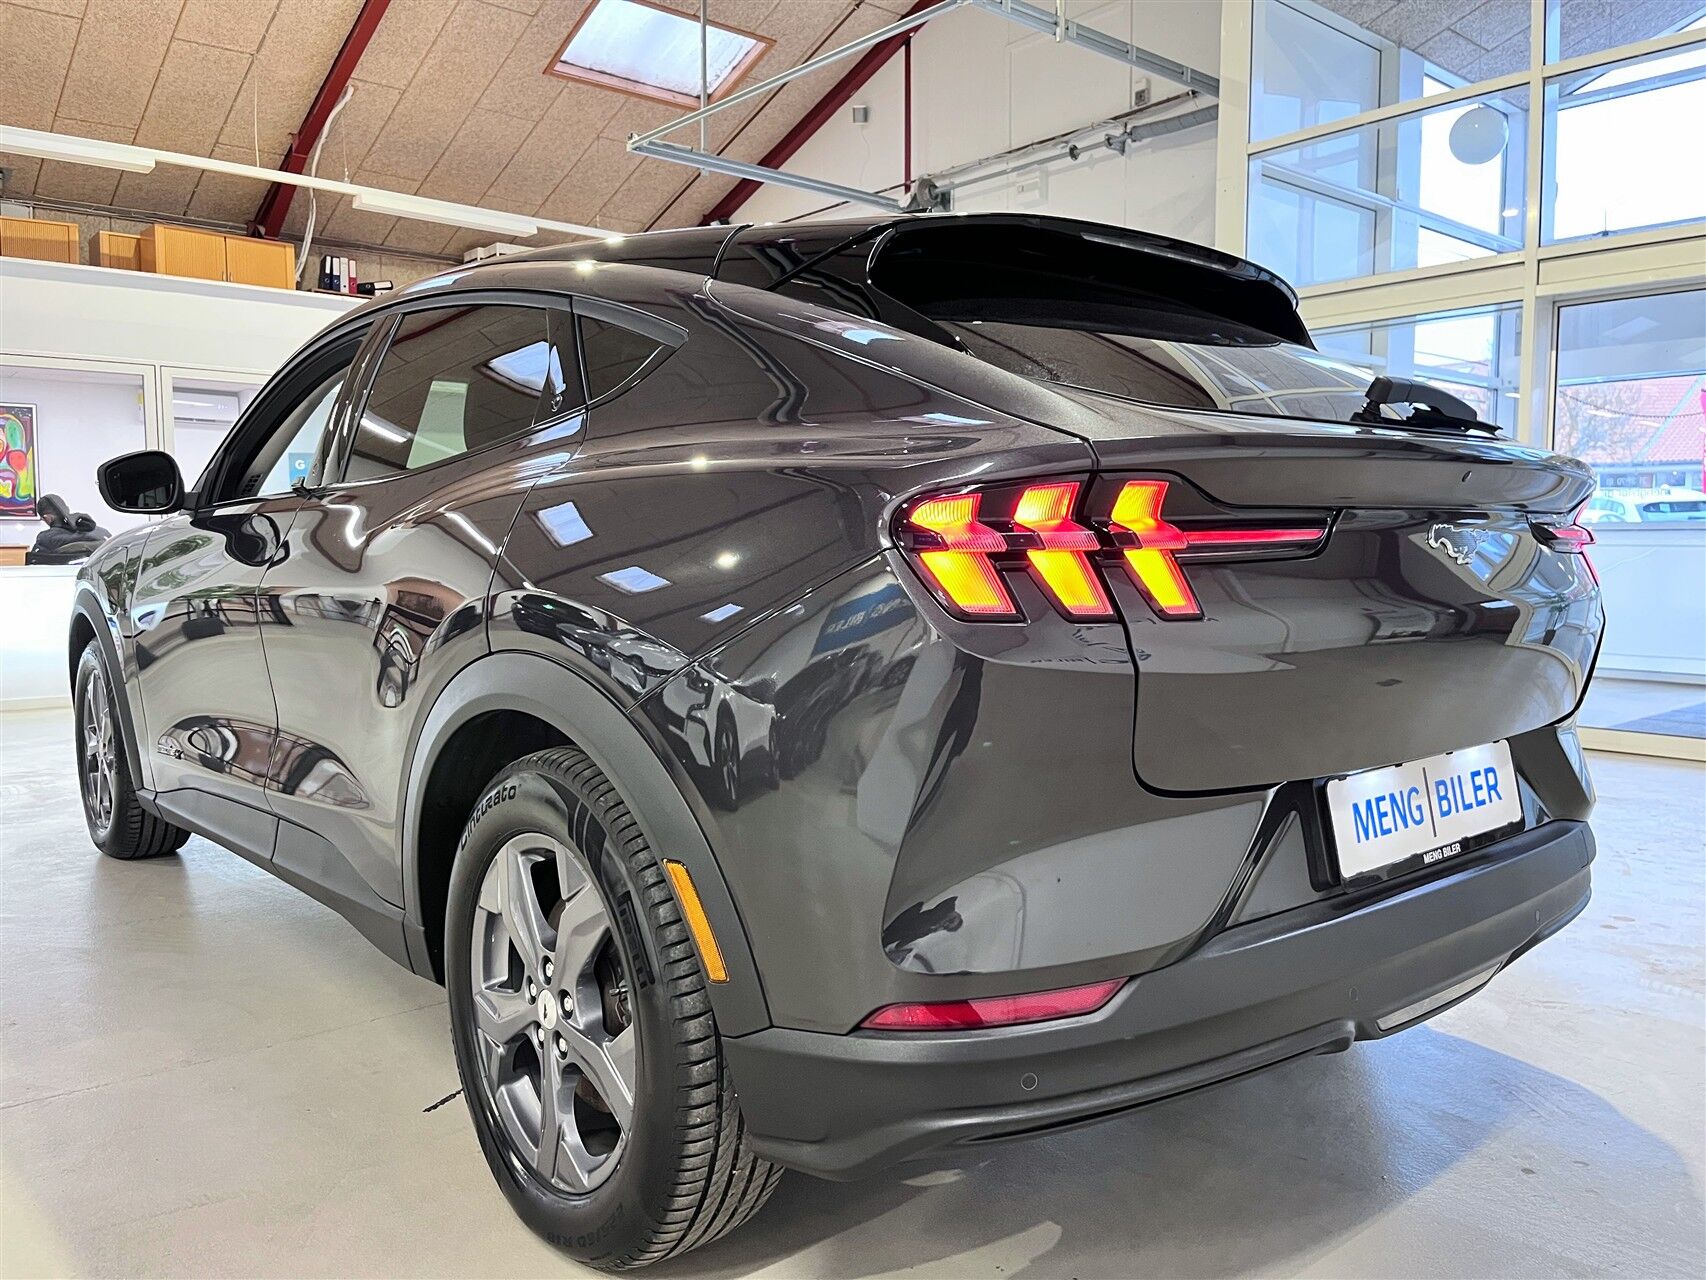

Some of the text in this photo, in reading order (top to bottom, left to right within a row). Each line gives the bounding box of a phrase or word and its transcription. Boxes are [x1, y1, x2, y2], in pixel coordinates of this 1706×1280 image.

[1352, 766, 1503, 844] MENG BILER
[1422, 843, 1462, 864] MENG BILER
